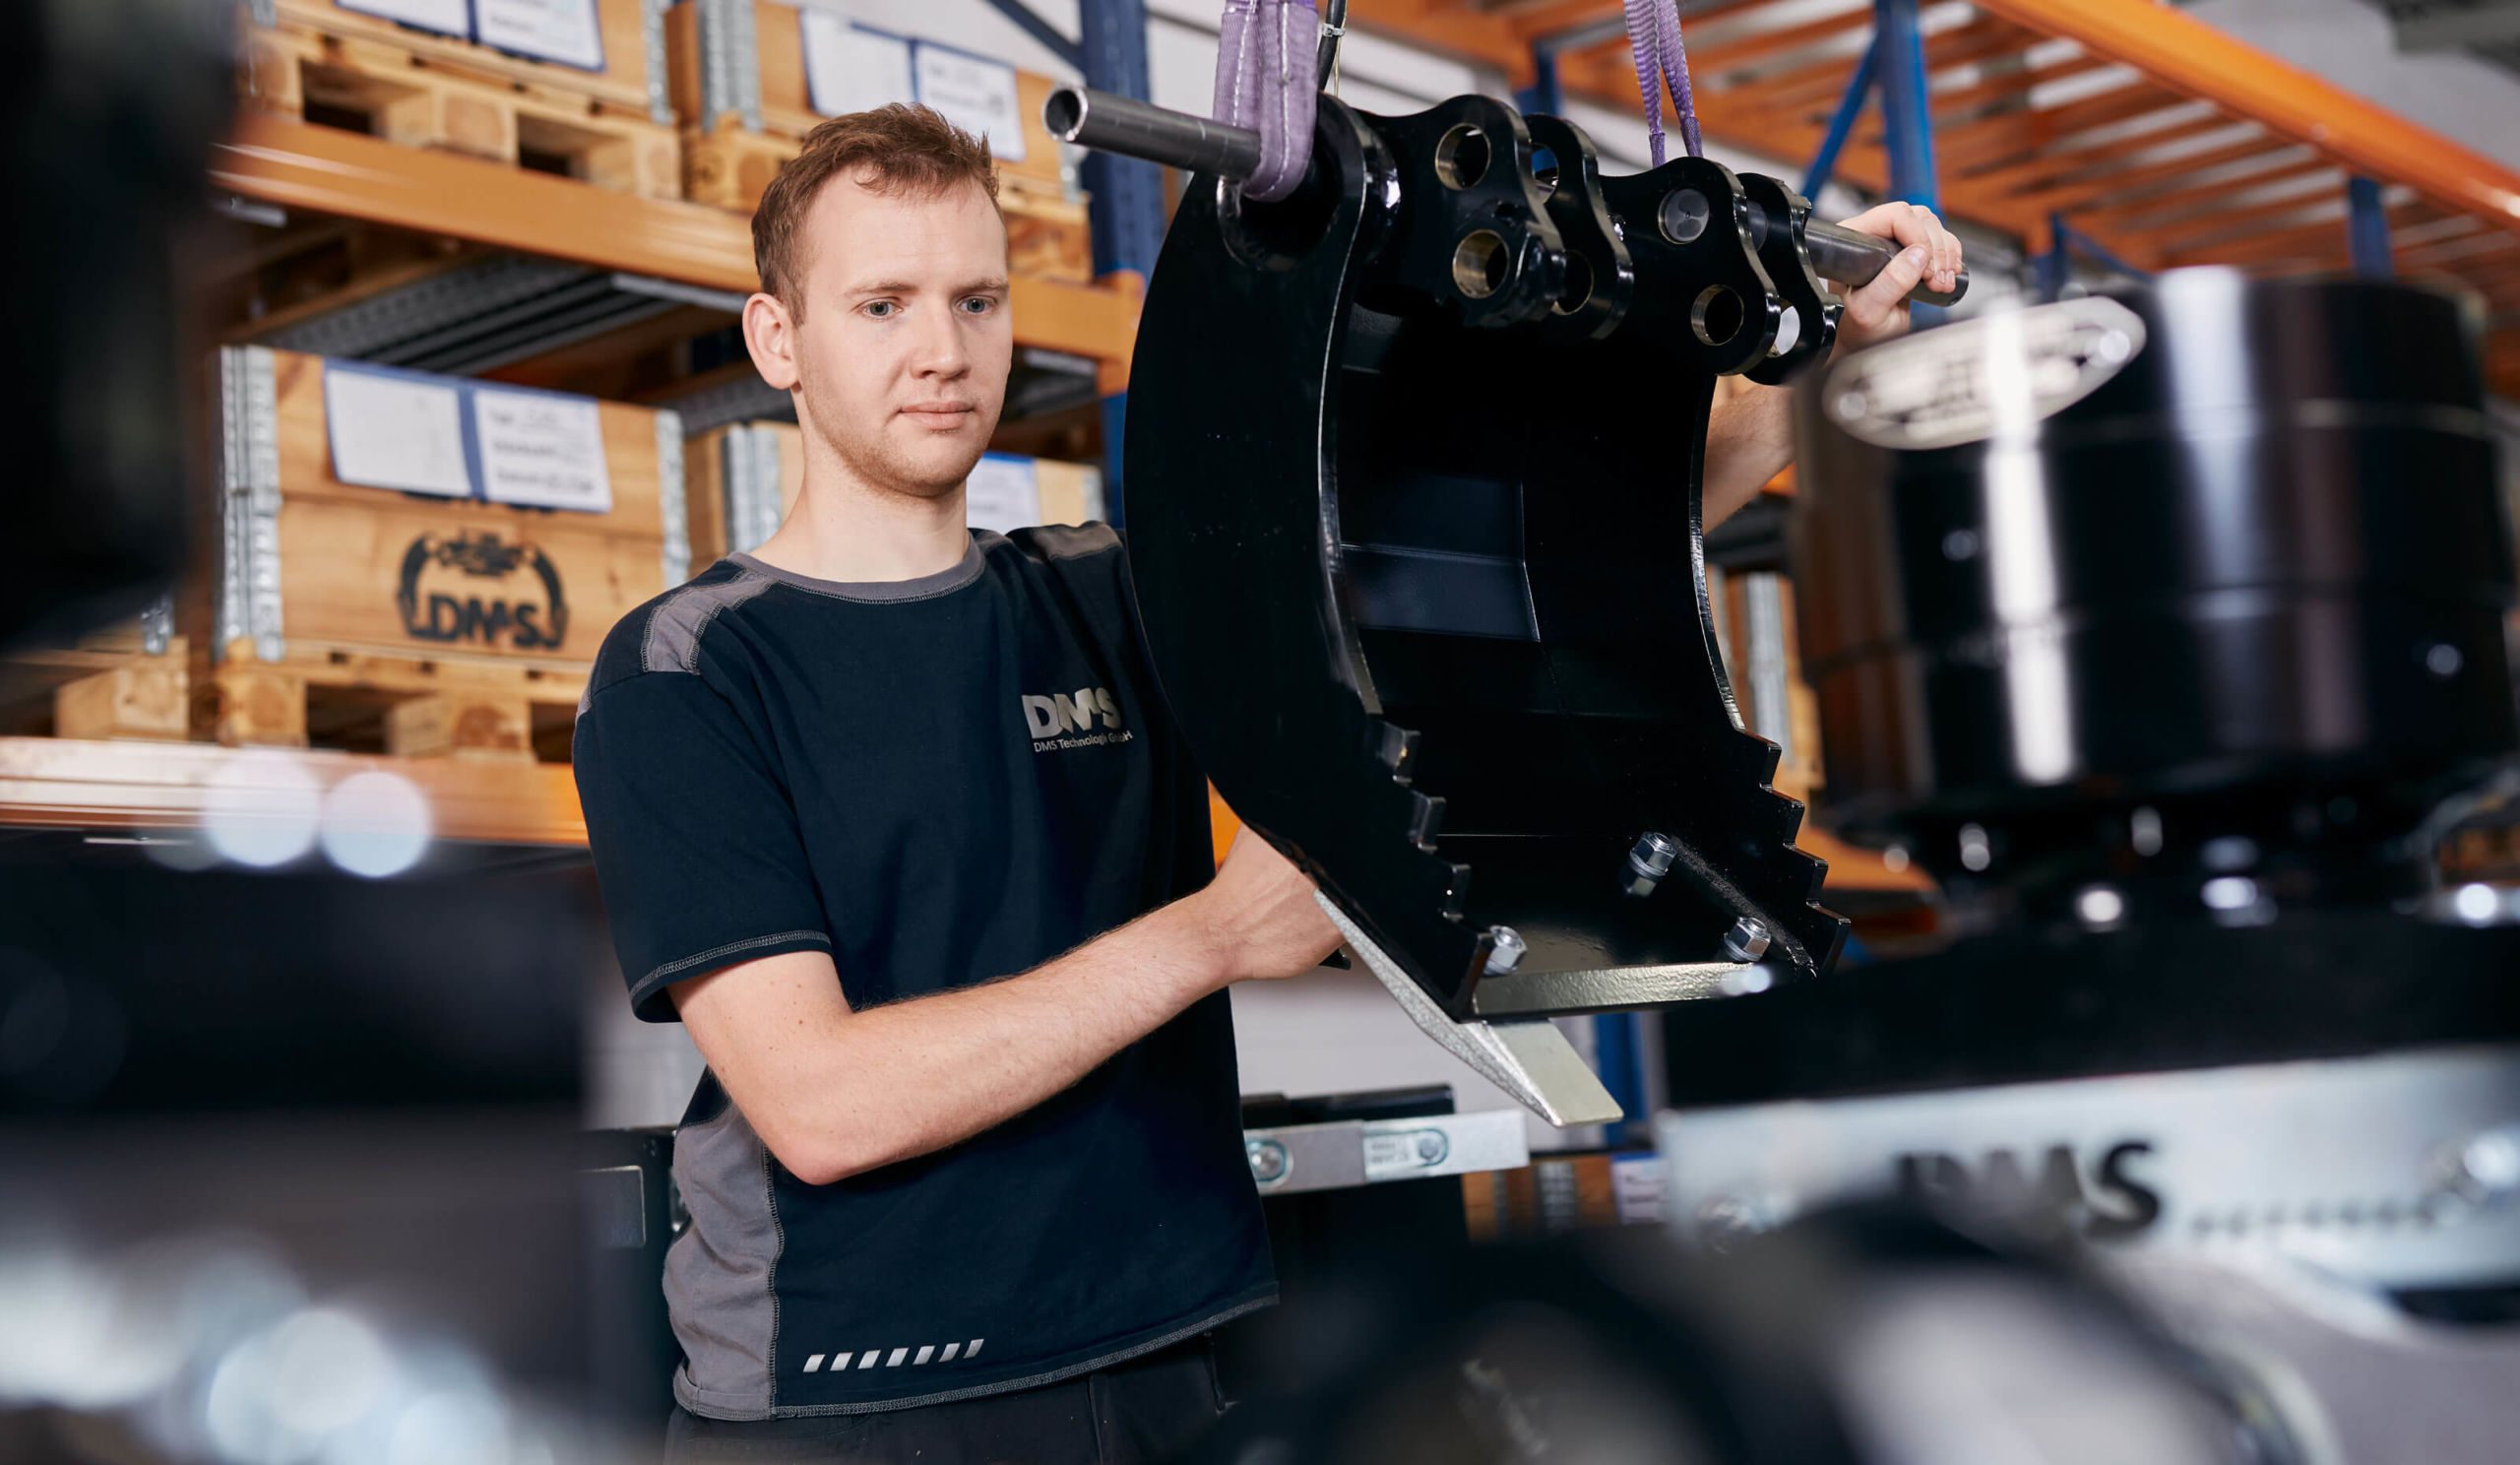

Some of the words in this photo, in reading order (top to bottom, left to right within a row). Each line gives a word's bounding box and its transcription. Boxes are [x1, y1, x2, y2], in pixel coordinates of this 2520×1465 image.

[429, 593, 539, 650] DMS
[1022, 687, 1121, 738] DMS
[1034, 740, 1057, 753] DMS
[1056, 733, 1108, 749] Technologi
